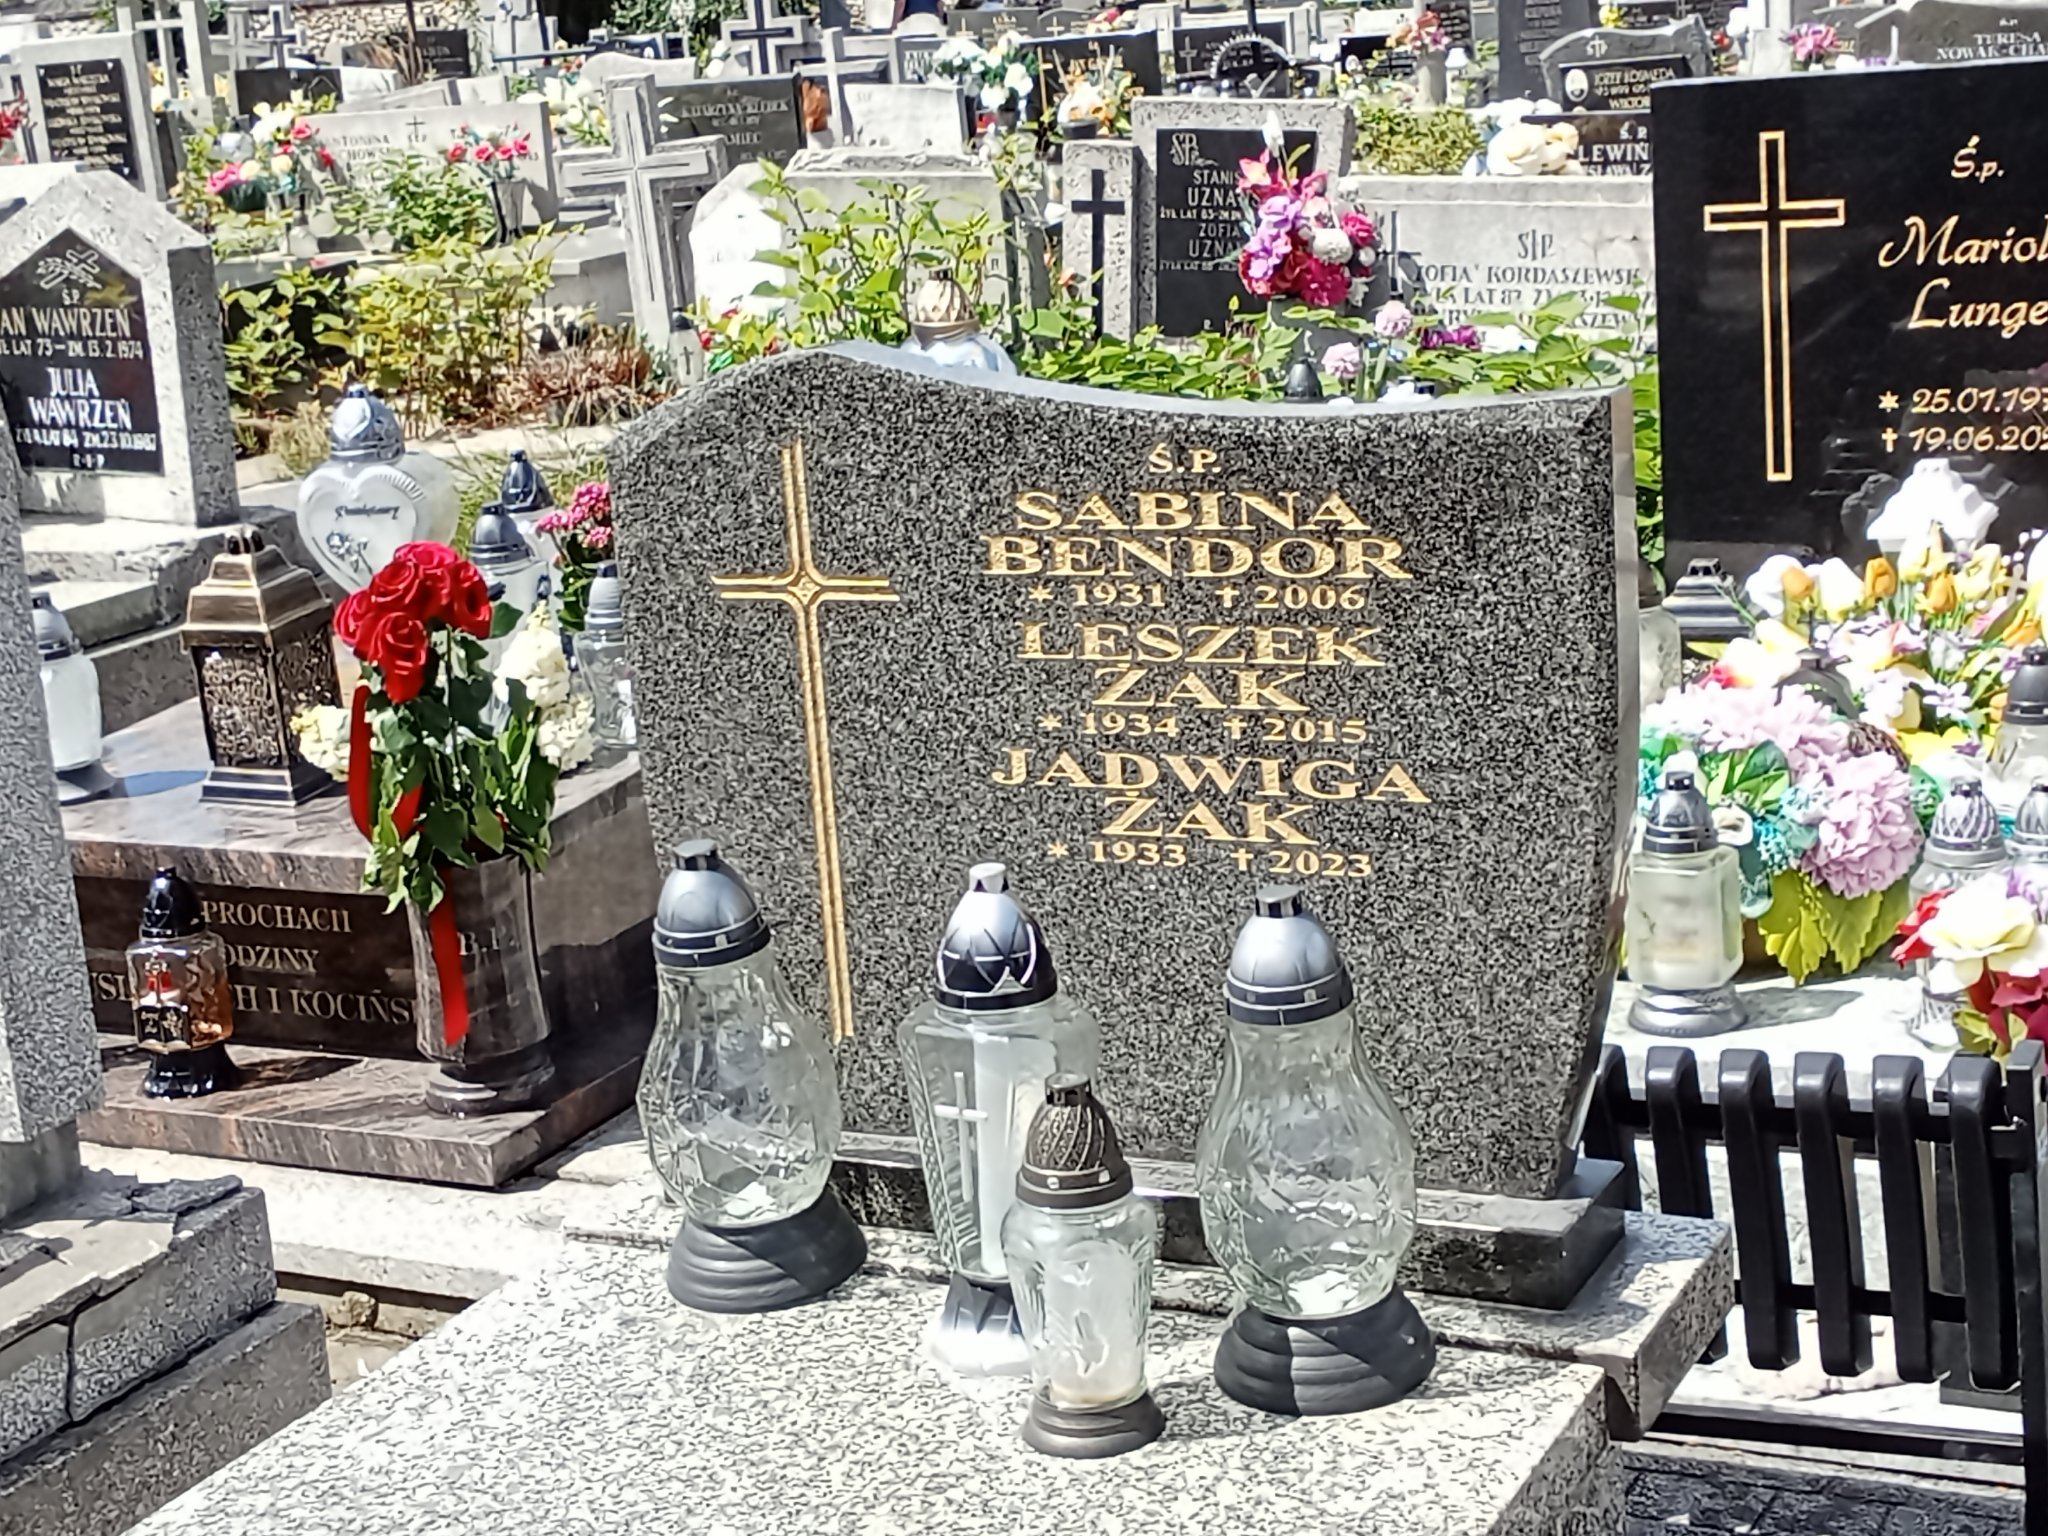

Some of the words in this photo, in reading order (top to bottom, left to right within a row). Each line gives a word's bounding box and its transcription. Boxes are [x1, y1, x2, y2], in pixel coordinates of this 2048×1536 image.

[1951, 135, 2004, 183] Ś.p.
[46, 367, 100, 397] JULIA
[1148, 442, 1222, 474] Ś.P.
[1015, 491, 1372, 532] SABINA
[981, 535, 1413, 580] BENDOR
[1073, 583, 1166, 608] 1931
[1255, 585, 1366, 610] 2006
[1016, 621, 1387, 667] LESZEK
[1083, 712, 1180, 738] 1934
[1262, 717, 1368, 744] 2015
[991, 748, 1433, 803] JADWIGA
[1090, 840, 1187, 867] 1933
[1268, 849, 1372, 878] 2023
[289, 990, 417, 1025] KOCIŃS
